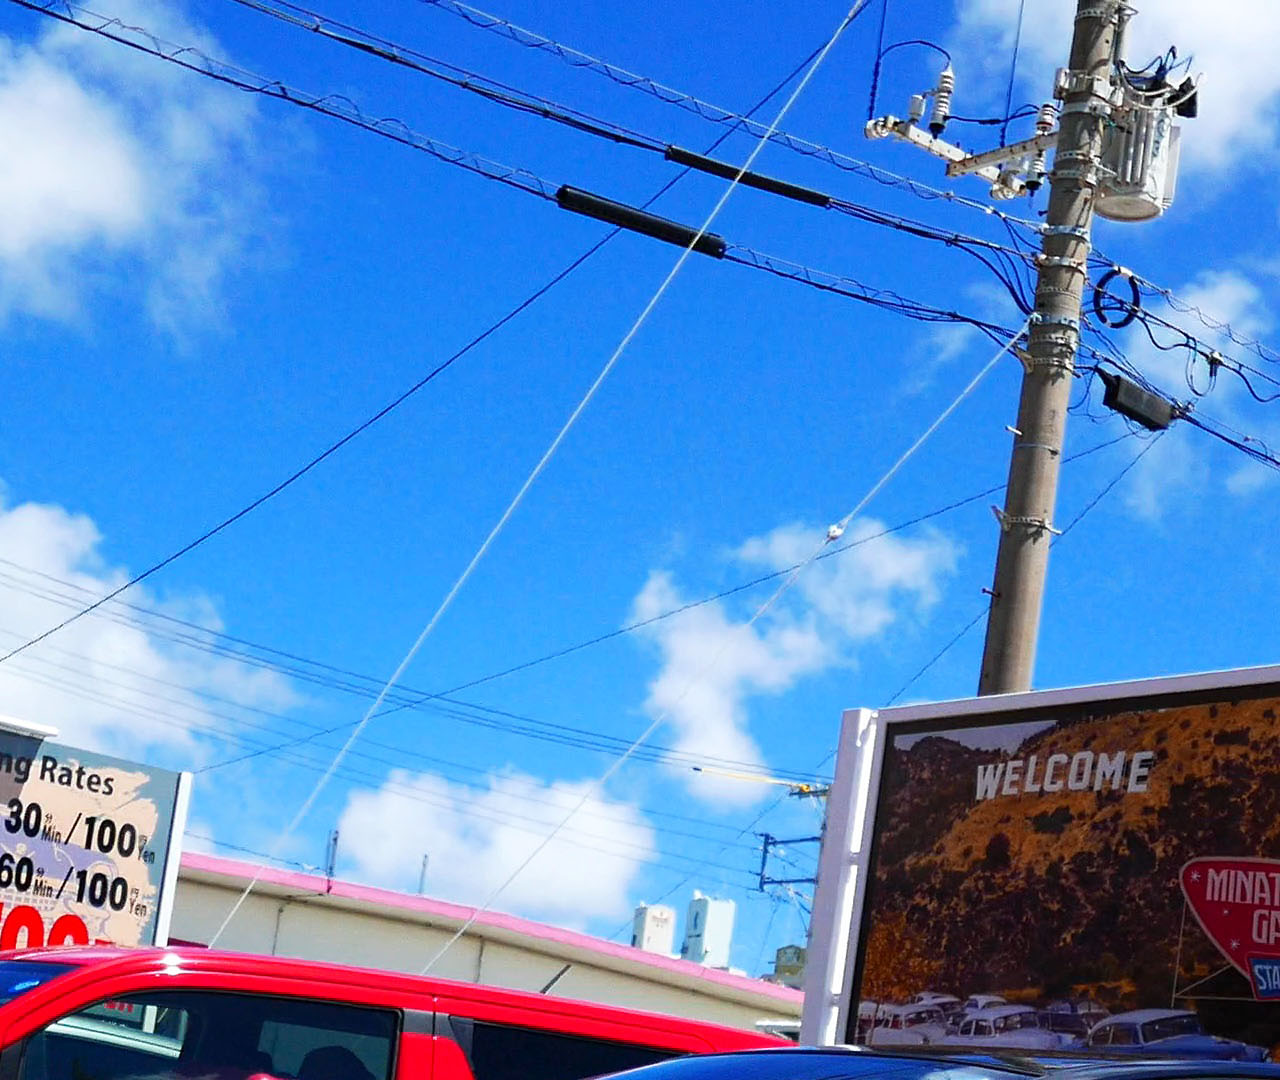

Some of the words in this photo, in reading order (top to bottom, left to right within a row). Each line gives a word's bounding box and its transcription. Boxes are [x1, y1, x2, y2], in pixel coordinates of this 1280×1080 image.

[39, 755, 114, 796] Rates
[975, 750, 1154, 800] WELCOME
[4, 798, 42, 837] 30
[42, 824, 62, 844] Min
[138, 843, 156, 865] Yen
[33, 879, 53, 899] Min
[129, 897, 147, 917] Yen
